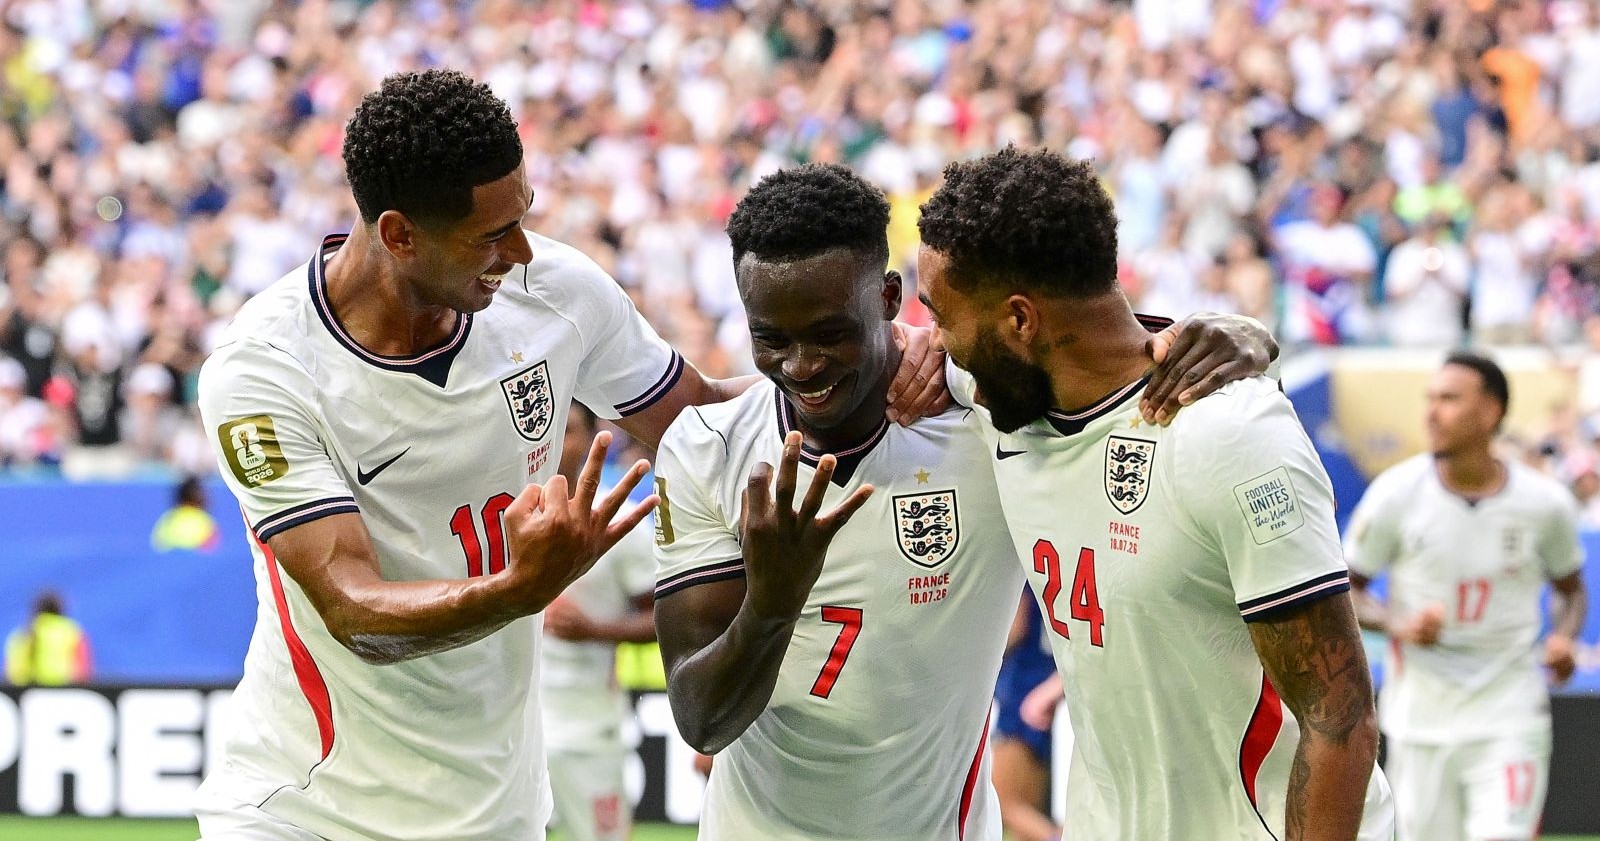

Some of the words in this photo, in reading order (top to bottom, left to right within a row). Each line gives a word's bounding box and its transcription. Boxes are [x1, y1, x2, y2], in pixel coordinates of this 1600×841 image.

[244, 467, 261, 477] WORLD
[260, 463, 271, 471] CUP
[246, 457, 260, 465] FIFA
[246, 468, 274, 483] 2026
[1244, 477, 1284, 502] FOOTBALL
[1249, 487, 1290, 514] UNITES
[1253, 514, 1270, 528] the
[1269, 499, 1296, 521] World
[1109, 521, 1140, 540] FRANCE
[1270, 520, 1287, 531] FIFA
[1110, 537, 1138, 555] 18.07.26
[908, 572, 950, 590] FRANCE
[910, 588, 948, 605] 18.07.26
[1033, 538, 1105, 648] 24
[1455, 576, 1492, 624] 17
[809, 604, 864, 700] 7
[1504, 761, 1536, 807] 17
